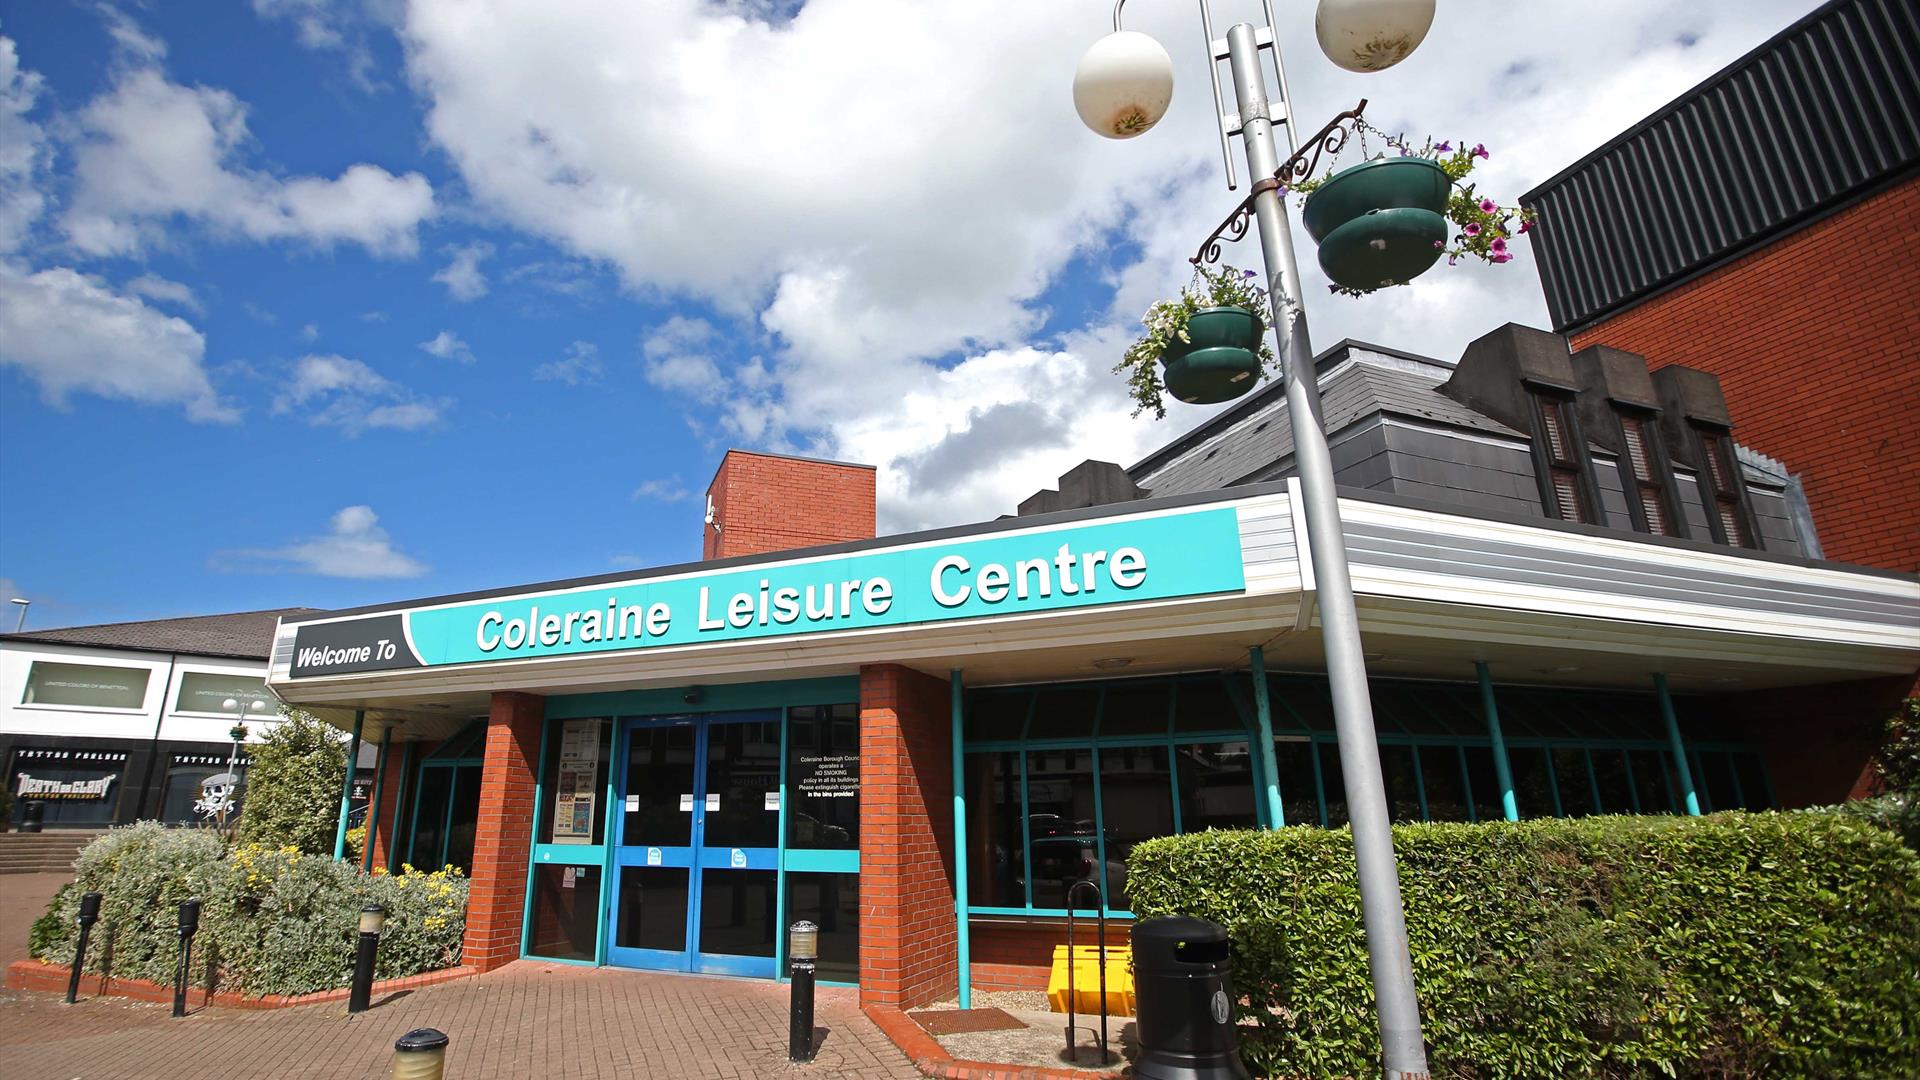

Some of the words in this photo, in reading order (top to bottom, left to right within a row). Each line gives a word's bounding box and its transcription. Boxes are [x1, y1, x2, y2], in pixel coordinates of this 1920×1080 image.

[476, 597, 671, 652] Coleraine
[698, 577, 894, 632] Leisure
[930, 542, 1147, 609] Centre
[297, 645, 371, 668] Welcome
[376, 639, 397, 661] To
[19, 750, 69, 759] TATTOO
[174, 755, 221, 764] TATTOO
